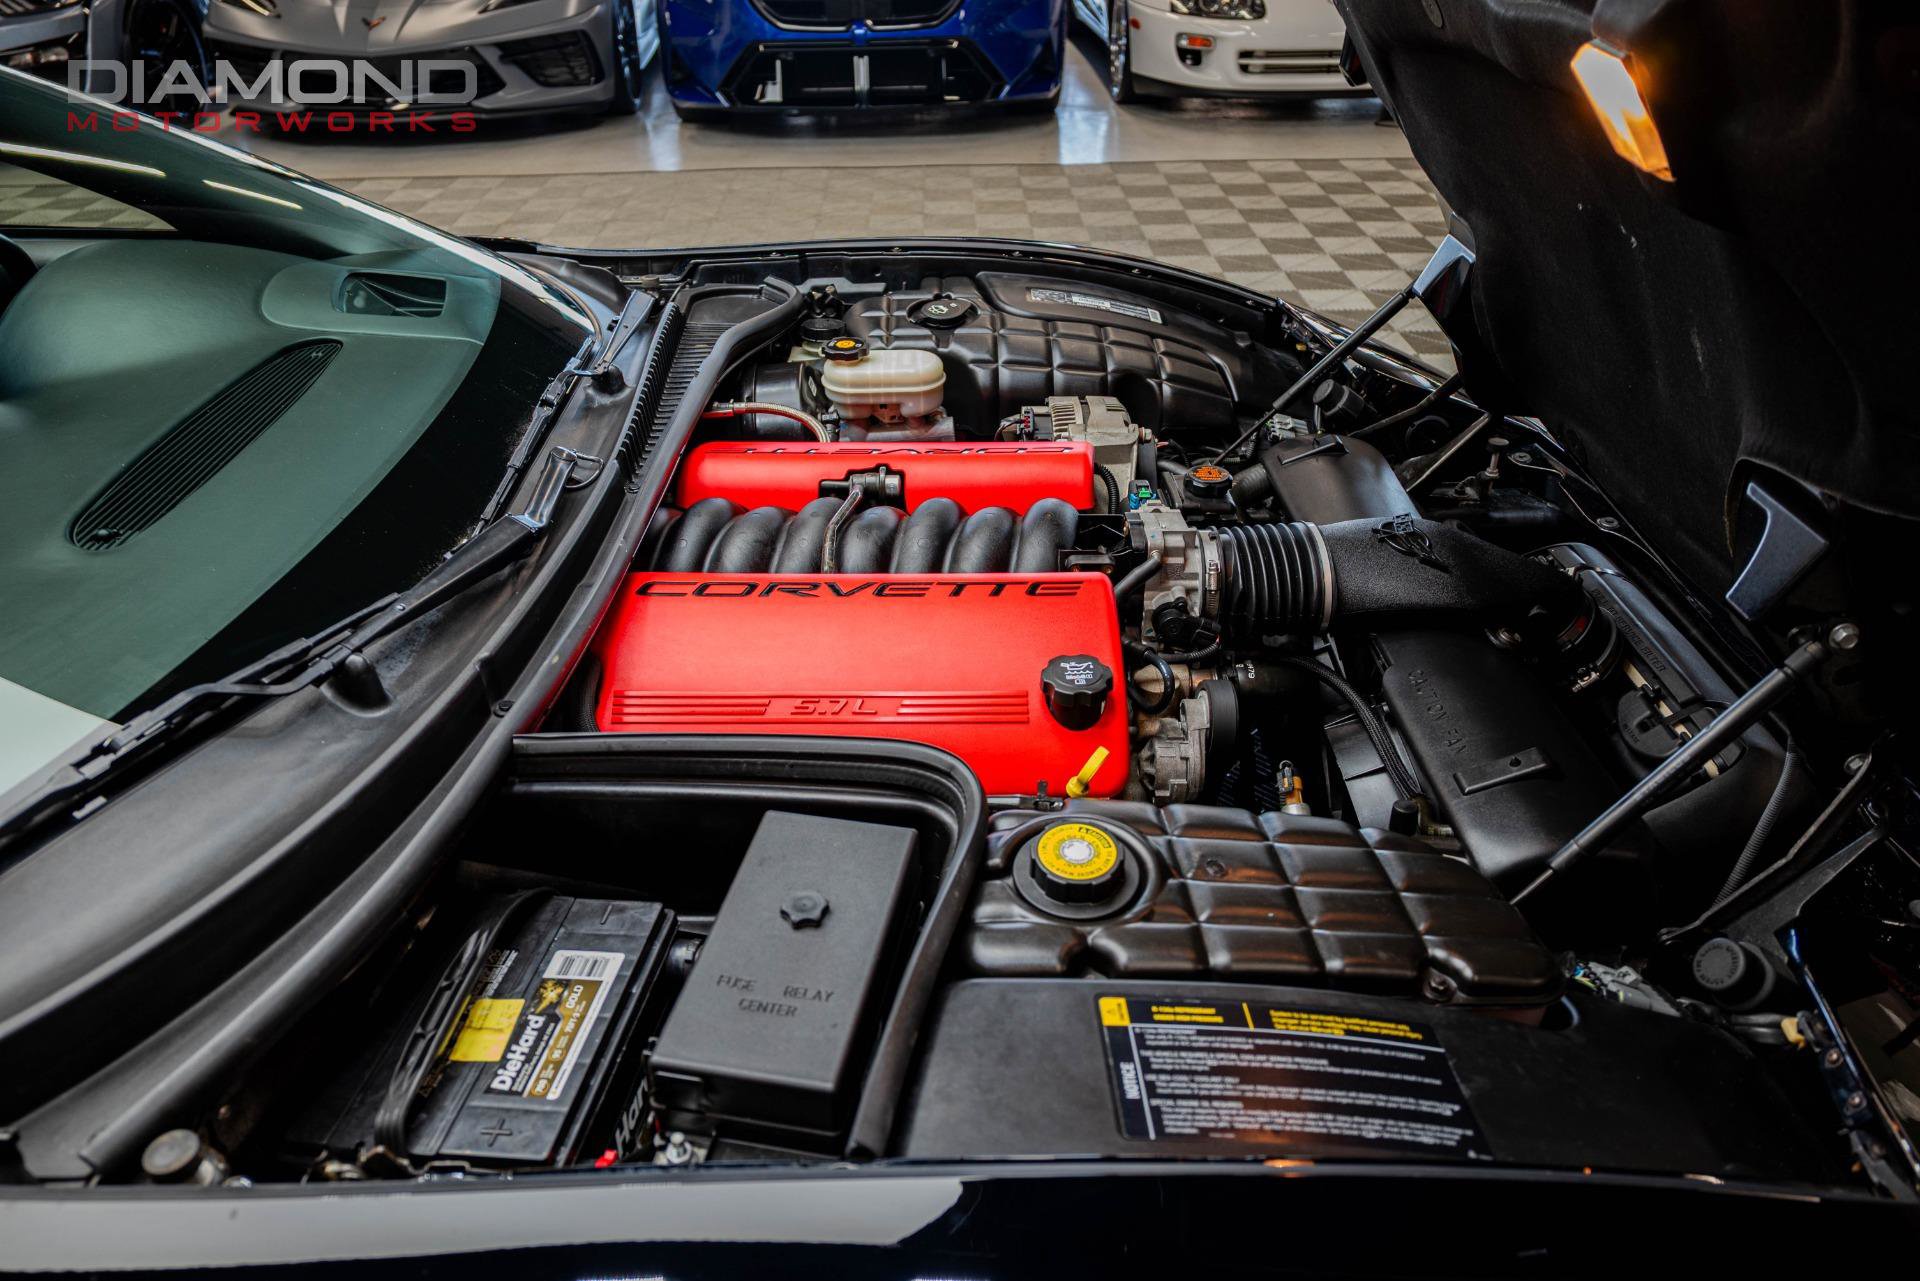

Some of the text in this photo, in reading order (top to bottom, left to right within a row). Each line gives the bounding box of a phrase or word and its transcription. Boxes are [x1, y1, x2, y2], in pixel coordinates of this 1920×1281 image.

[634, 581, 1084, 597] CORVETTE
[790, 698, 878, 716] 5.7L
[565, 984, 584, 1009] GOLD
[716, 974, 834, 1002] FUSE RELAY
[738, 998, 798, 1017] CENTER
[490, 1013, 547, 1092] DieHard
[1119, 1062, 1141, 1100] NOTICE
